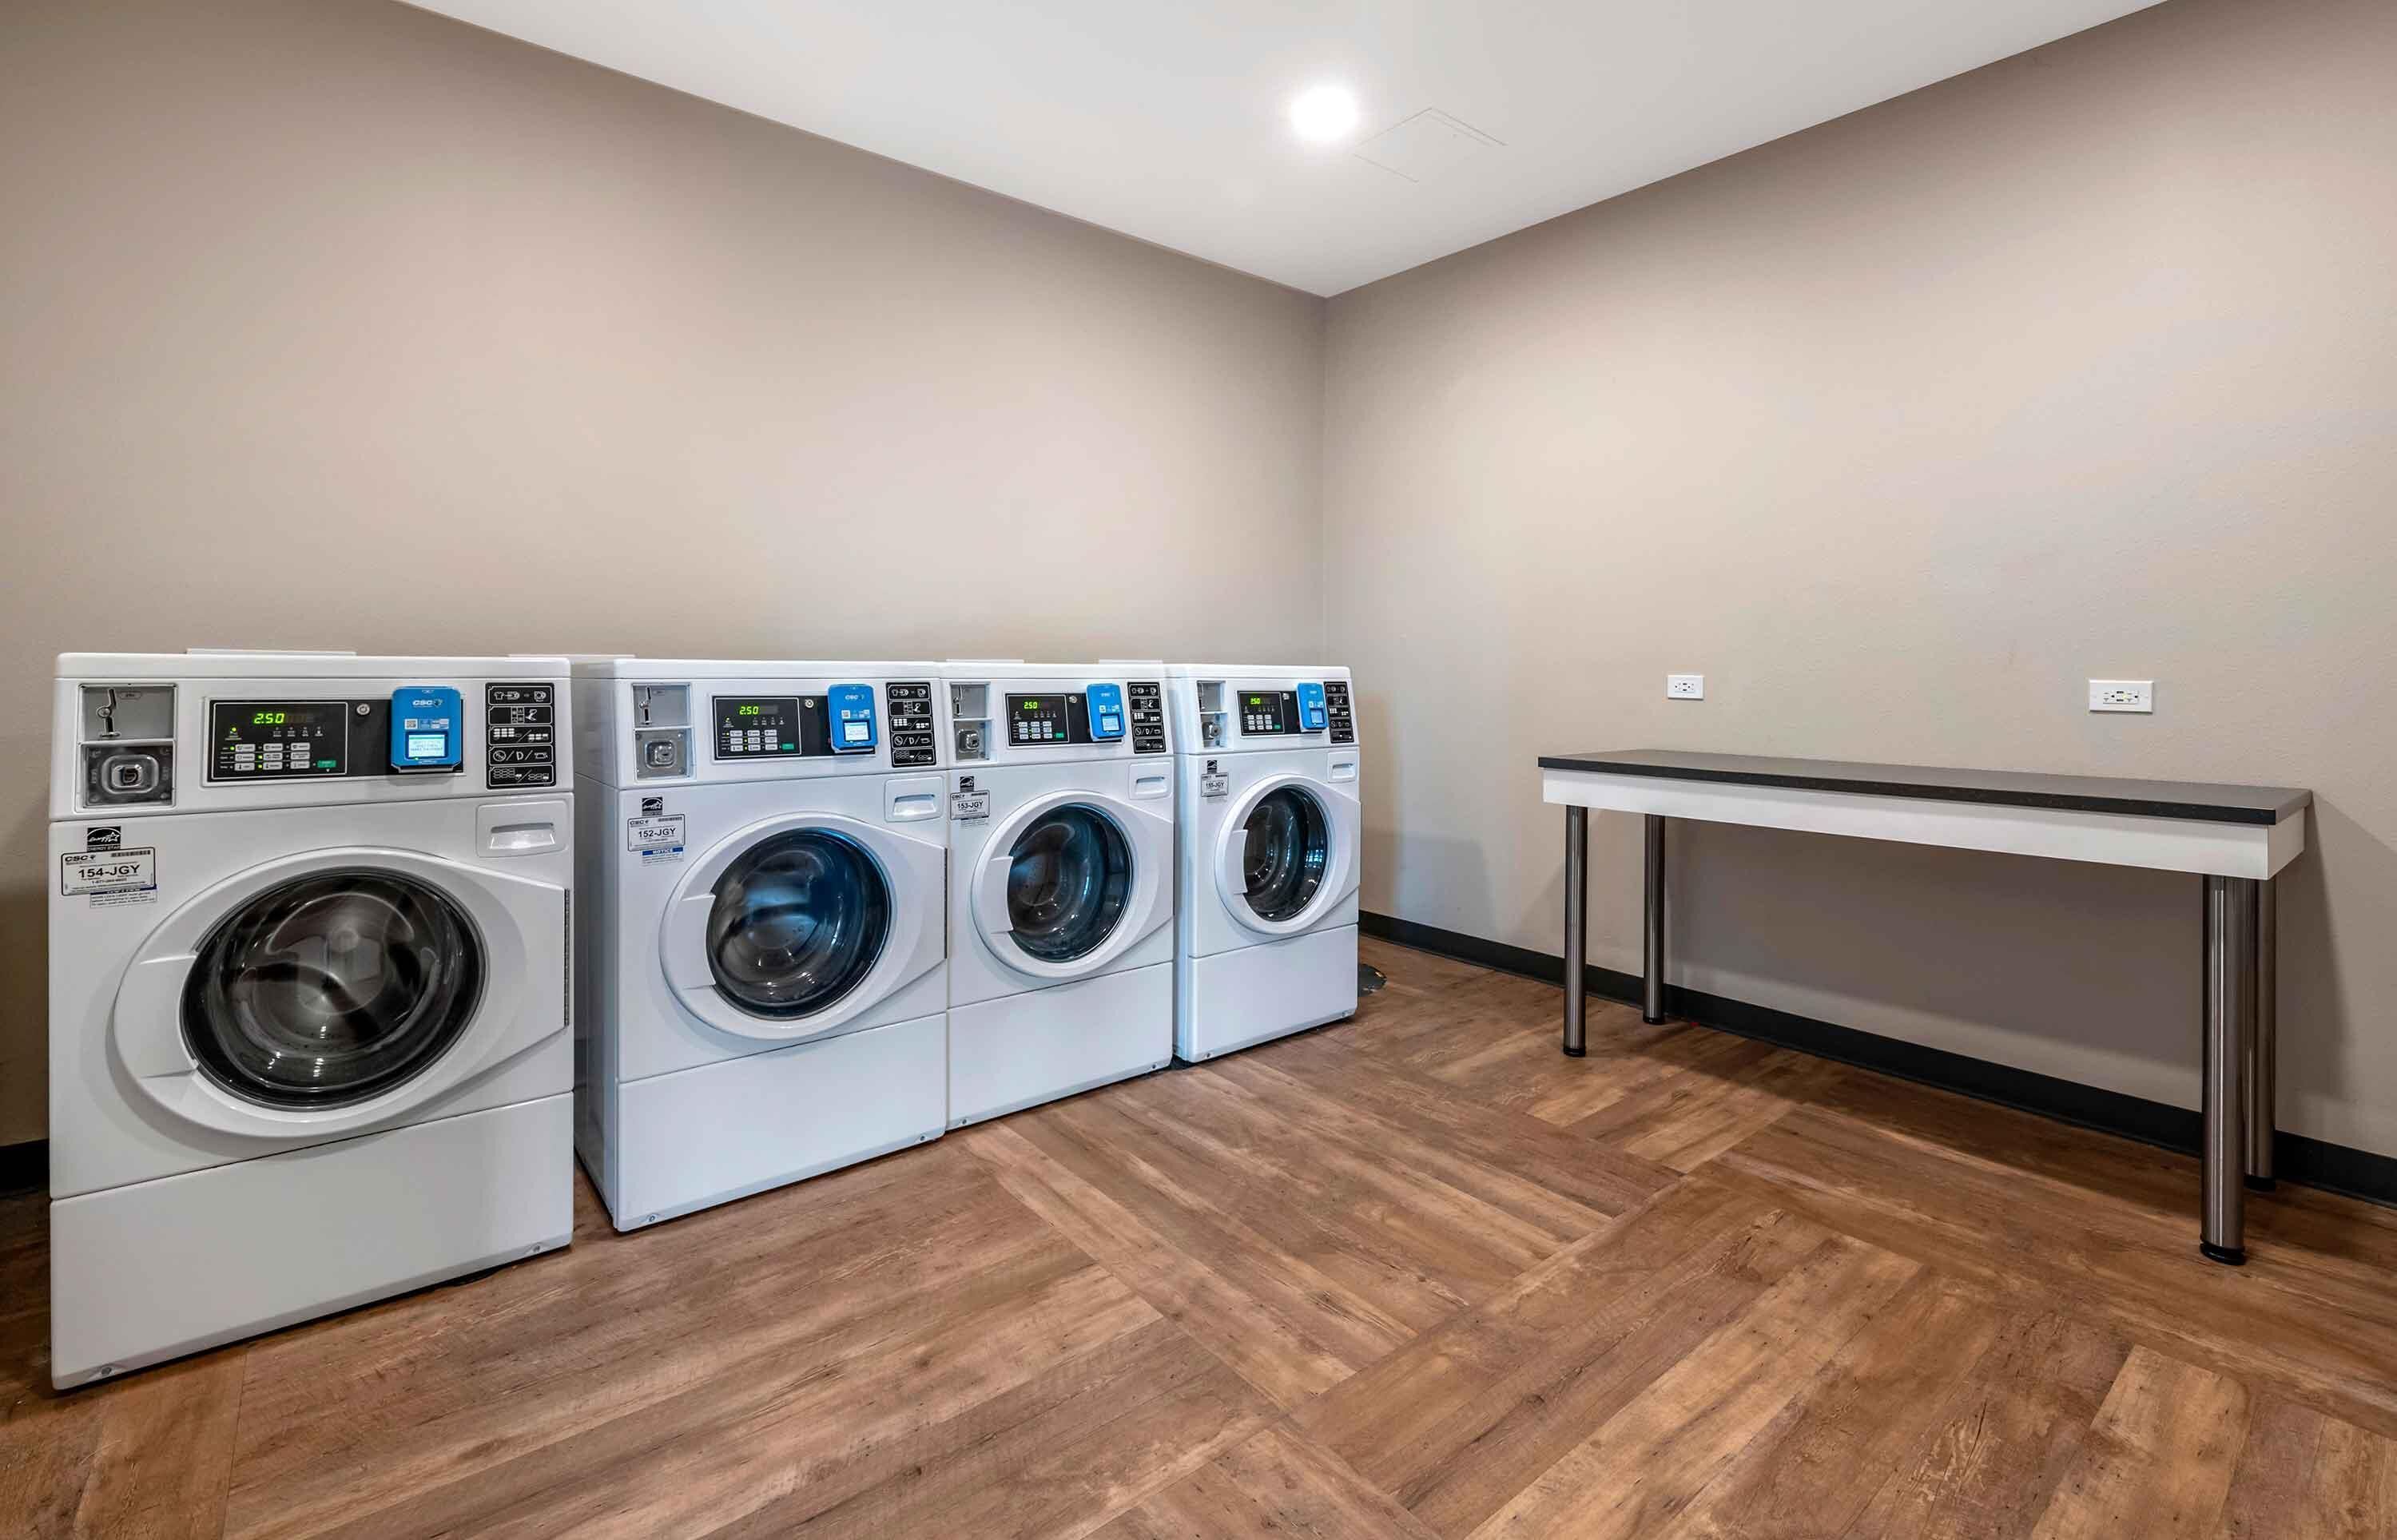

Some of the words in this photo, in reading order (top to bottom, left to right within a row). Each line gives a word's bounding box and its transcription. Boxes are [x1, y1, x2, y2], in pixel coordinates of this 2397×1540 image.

[739, 706, 759, 715] 2.50
[253, 712, 285, 724] 2.50
[638, 828, 676, 838] 152-JGY
[78, 864, 140, 879] 154-JGY
